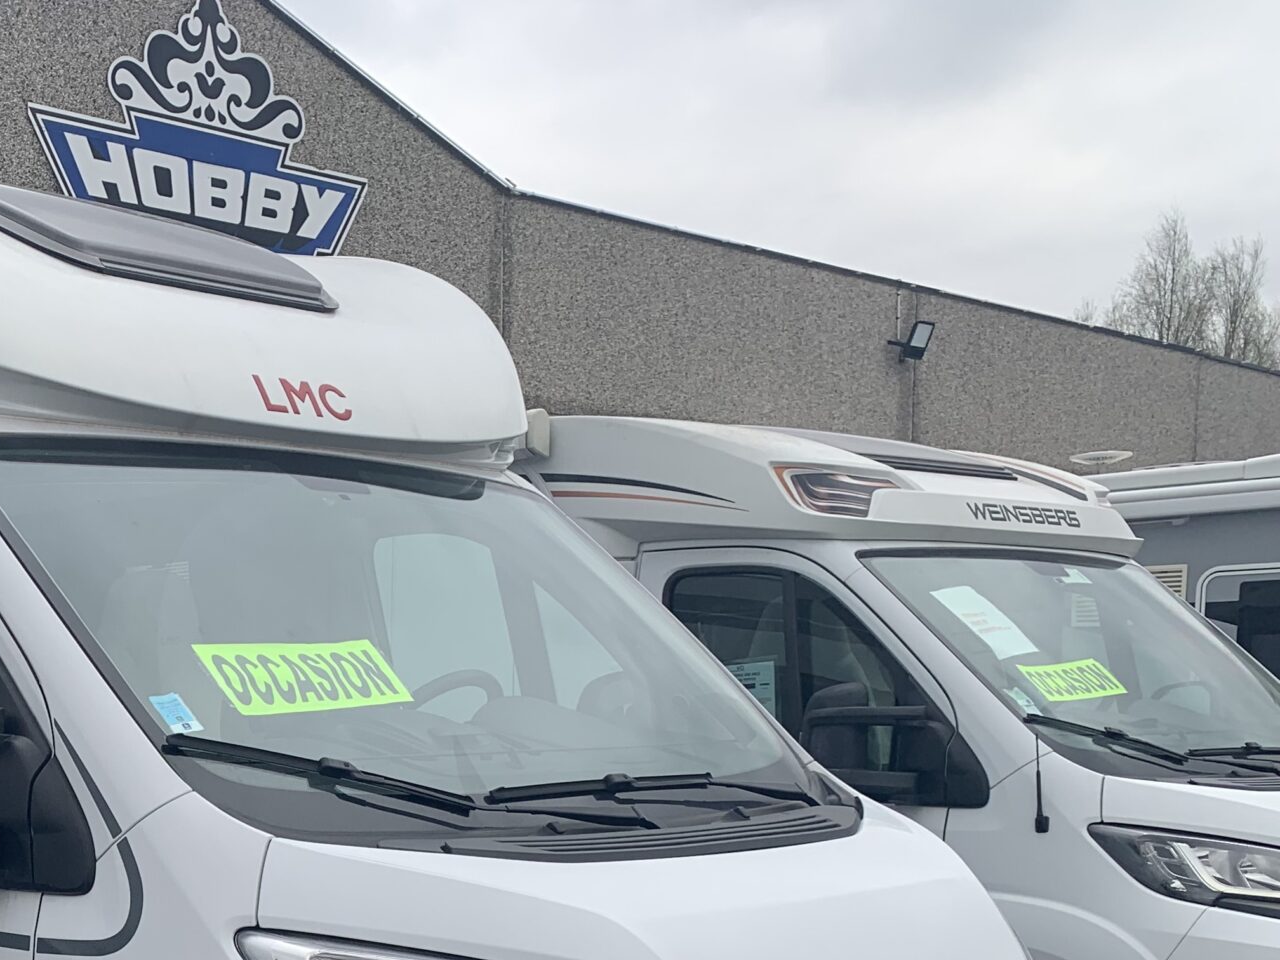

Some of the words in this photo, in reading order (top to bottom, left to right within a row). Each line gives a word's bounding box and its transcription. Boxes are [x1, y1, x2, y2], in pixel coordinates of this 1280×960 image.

[63, 131, 347, 240] HOBBY
[251, 373, 353, 422] LMC
[965, 501, 1081, 528] WEINSBERG
[211, 649, 400, 706] OCCASION
[1025, 662, 1120, 697] OCCASION
